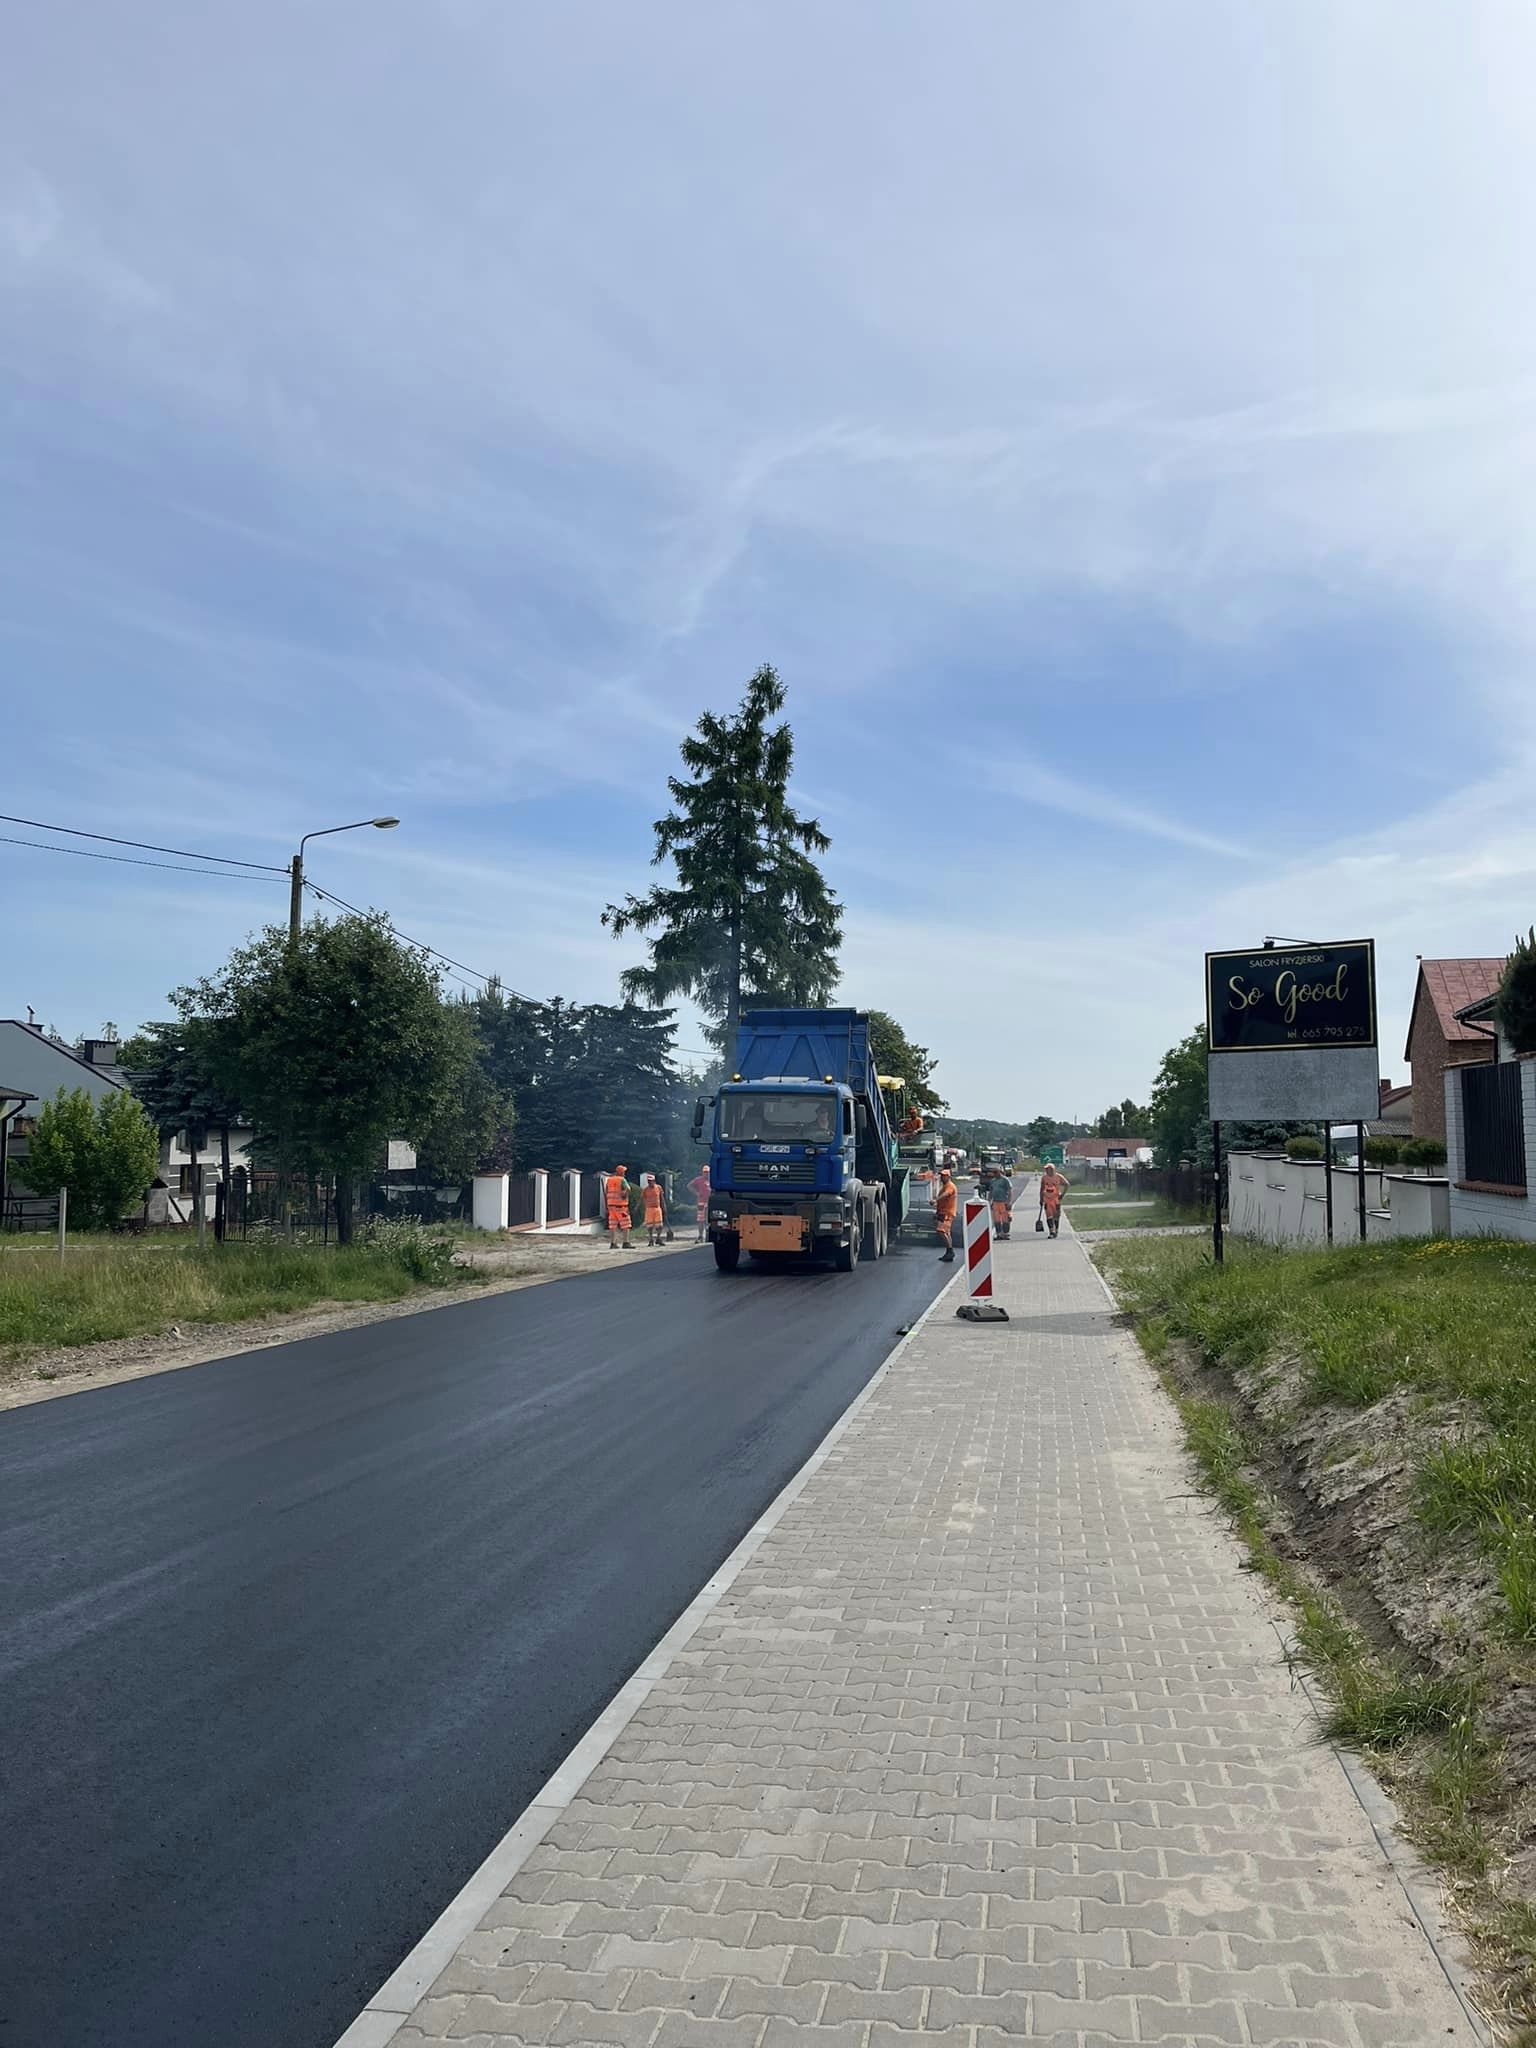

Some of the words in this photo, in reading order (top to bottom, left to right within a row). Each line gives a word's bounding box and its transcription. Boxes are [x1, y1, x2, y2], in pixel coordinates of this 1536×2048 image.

[1249, 958, 1279, 968] SALON
[1229, 975, 1264, 1010] So
[1275, 964, 1348, 1023] Good
[1323, 1026, 1343, 1037] 795
